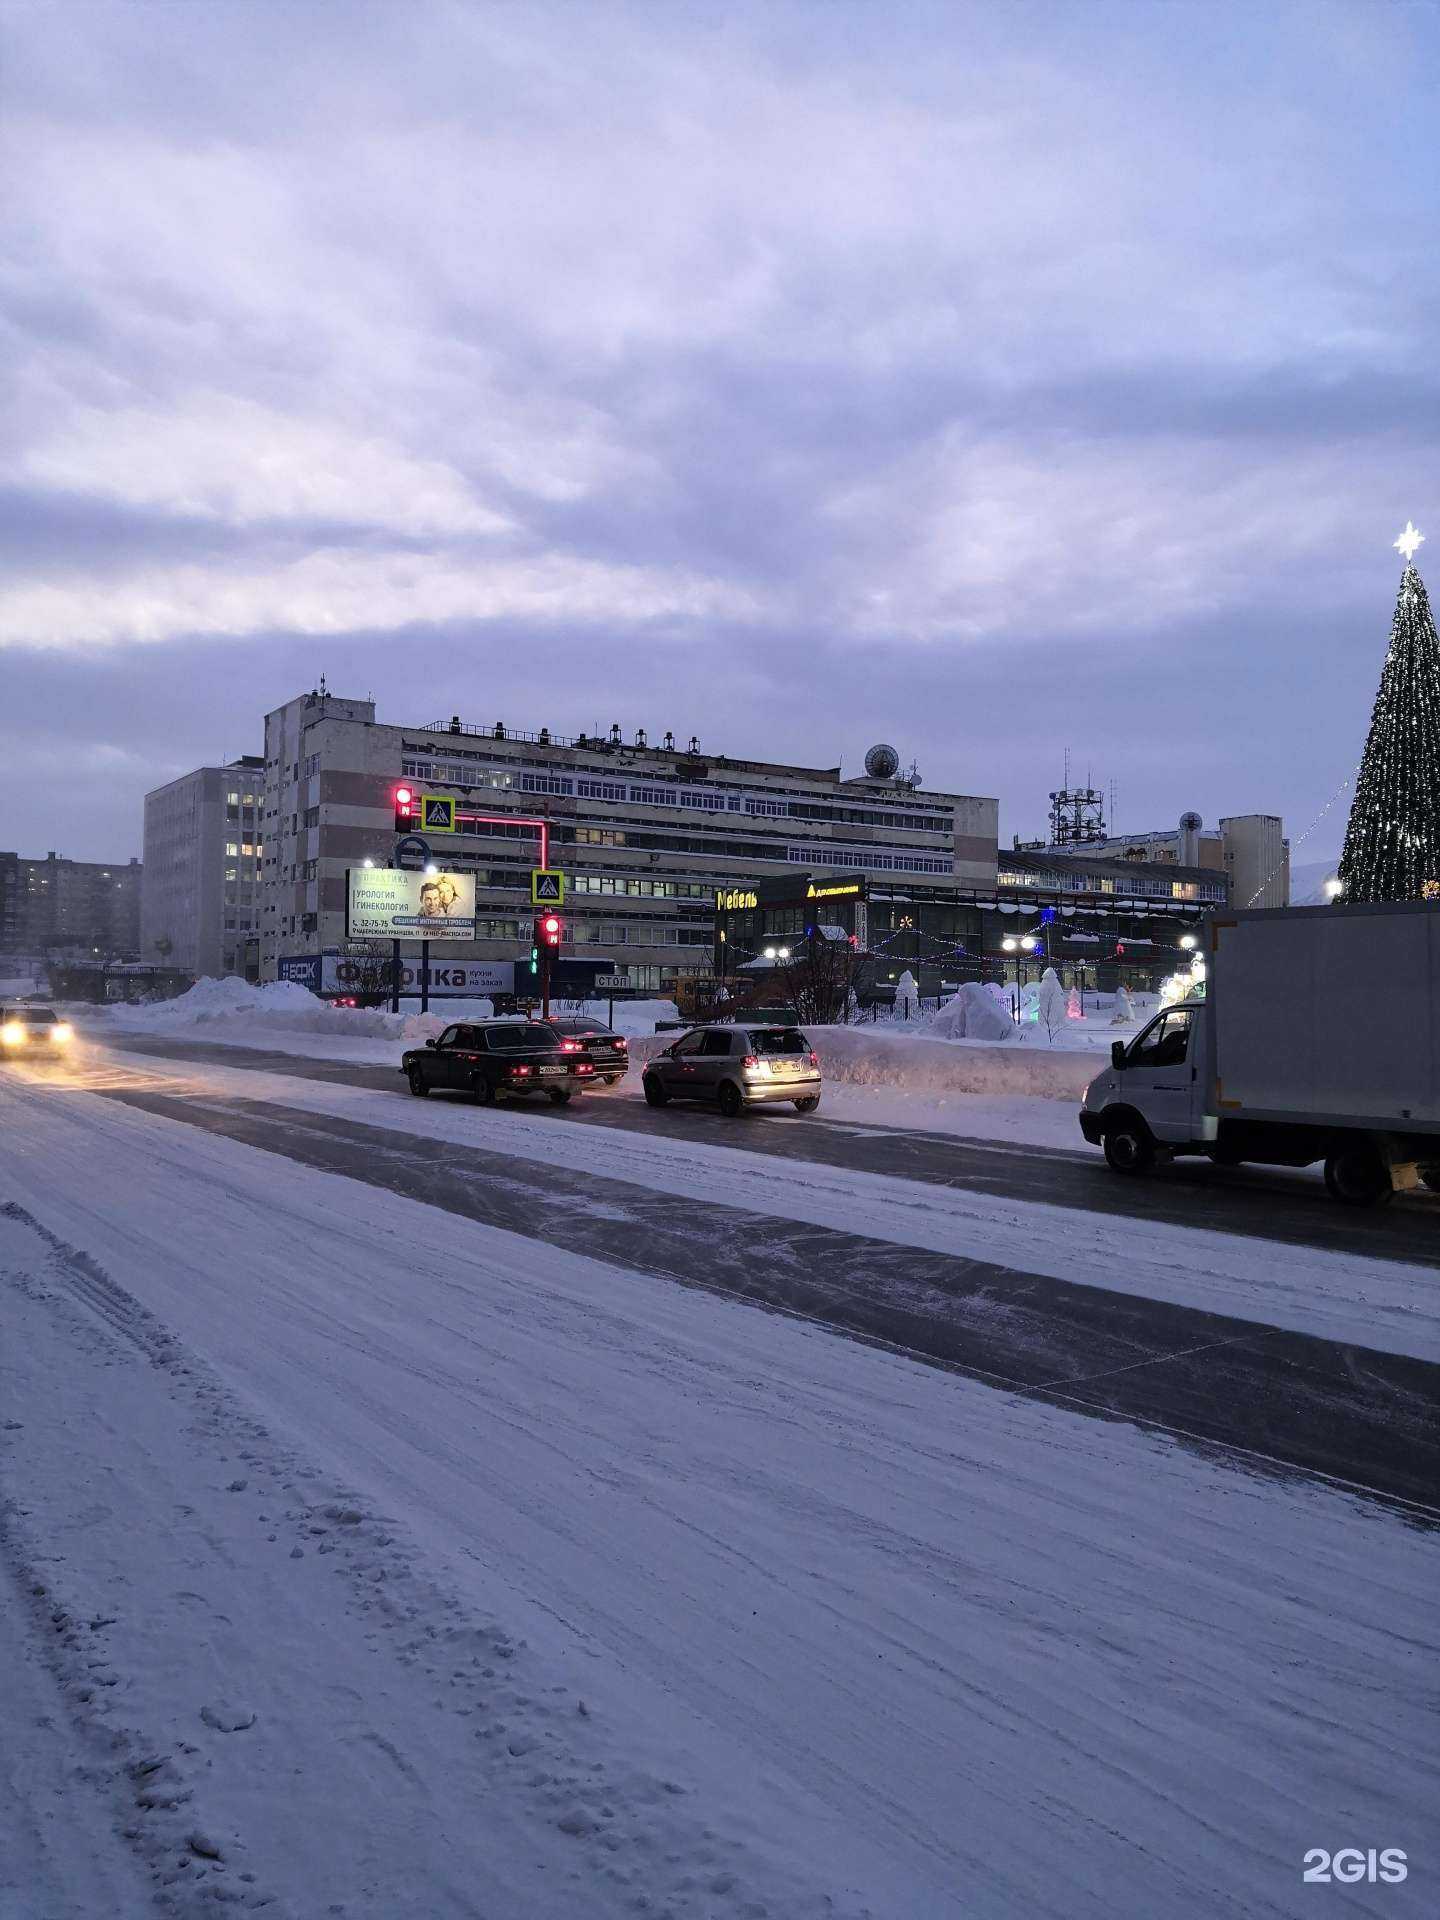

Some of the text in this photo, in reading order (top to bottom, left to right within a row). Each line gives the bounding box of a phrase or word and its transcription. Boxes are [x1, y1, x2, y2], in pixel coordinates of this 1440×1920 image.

[356, 889, 395, 899] УРОЛОГИЯ
[716, 889, 758, 911] Мебель
[356, 901, 409, 911] ГИНЕКОЛОГИЯ
[360, 919, 389, 928] 32-75-75
[336, 960, 466, 987] Фрика
[599, 976, 627, 987] СТОП
